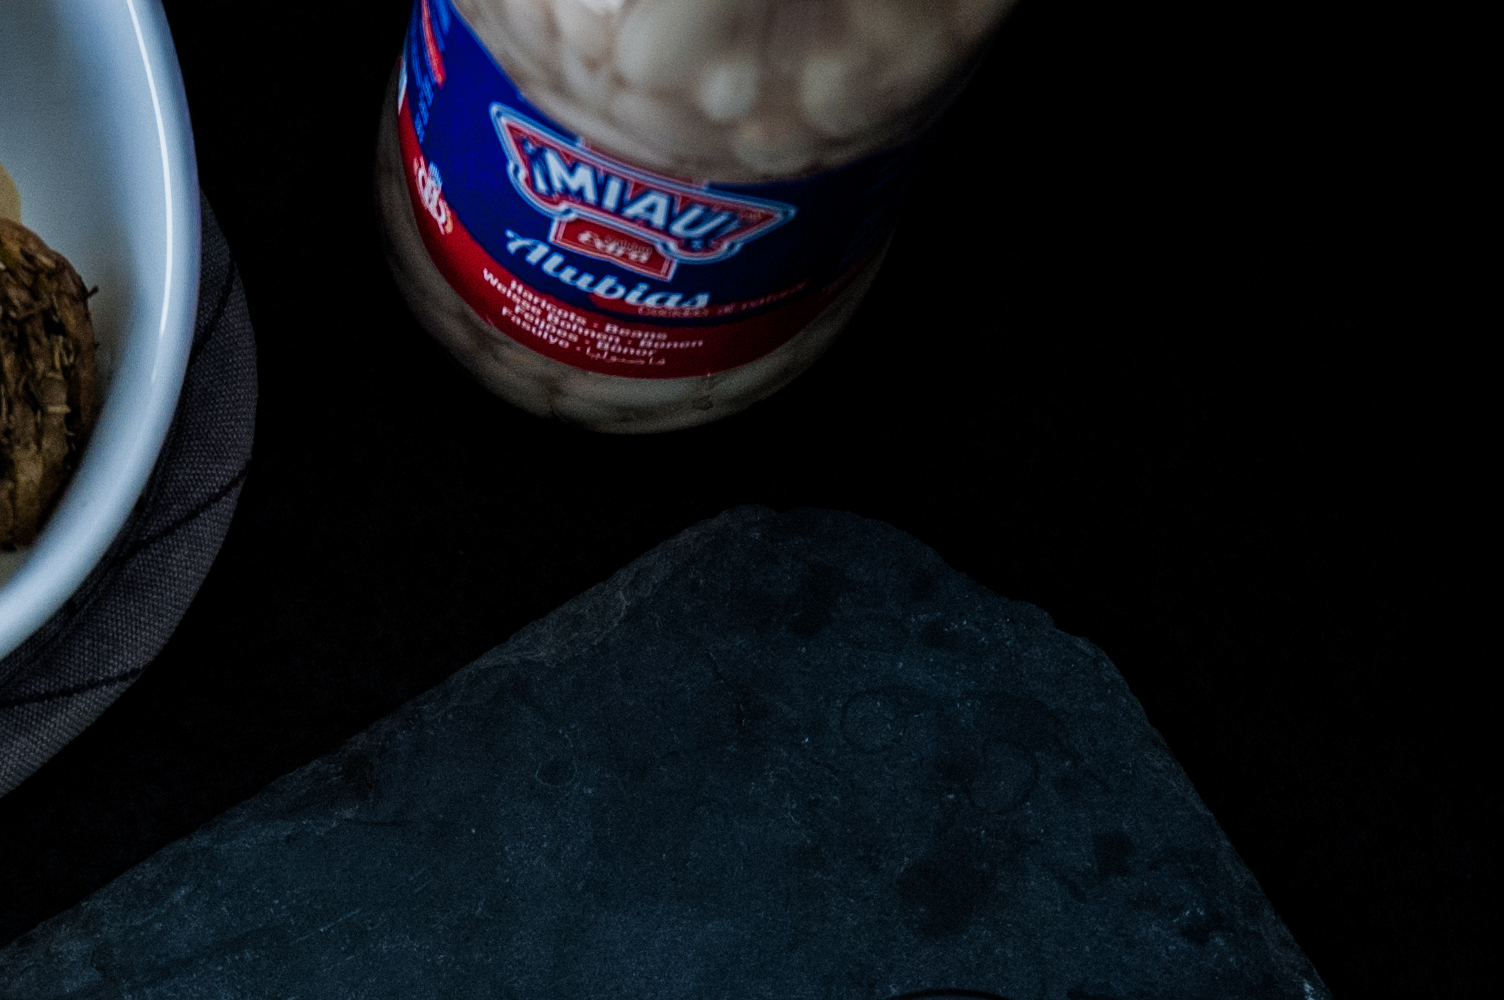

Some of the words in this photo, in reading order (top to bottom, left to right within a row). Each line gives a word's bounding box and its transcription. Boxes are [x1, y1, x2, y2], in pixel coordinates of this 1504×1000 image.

[483, 267, 542, 316] Weisse
[547, 312, 620, 344] Bohnen
[505, 229, 710, 307] Alubias
[510, 279, 587, 326] Haricots
[604, 323, 668, 340] Beans
